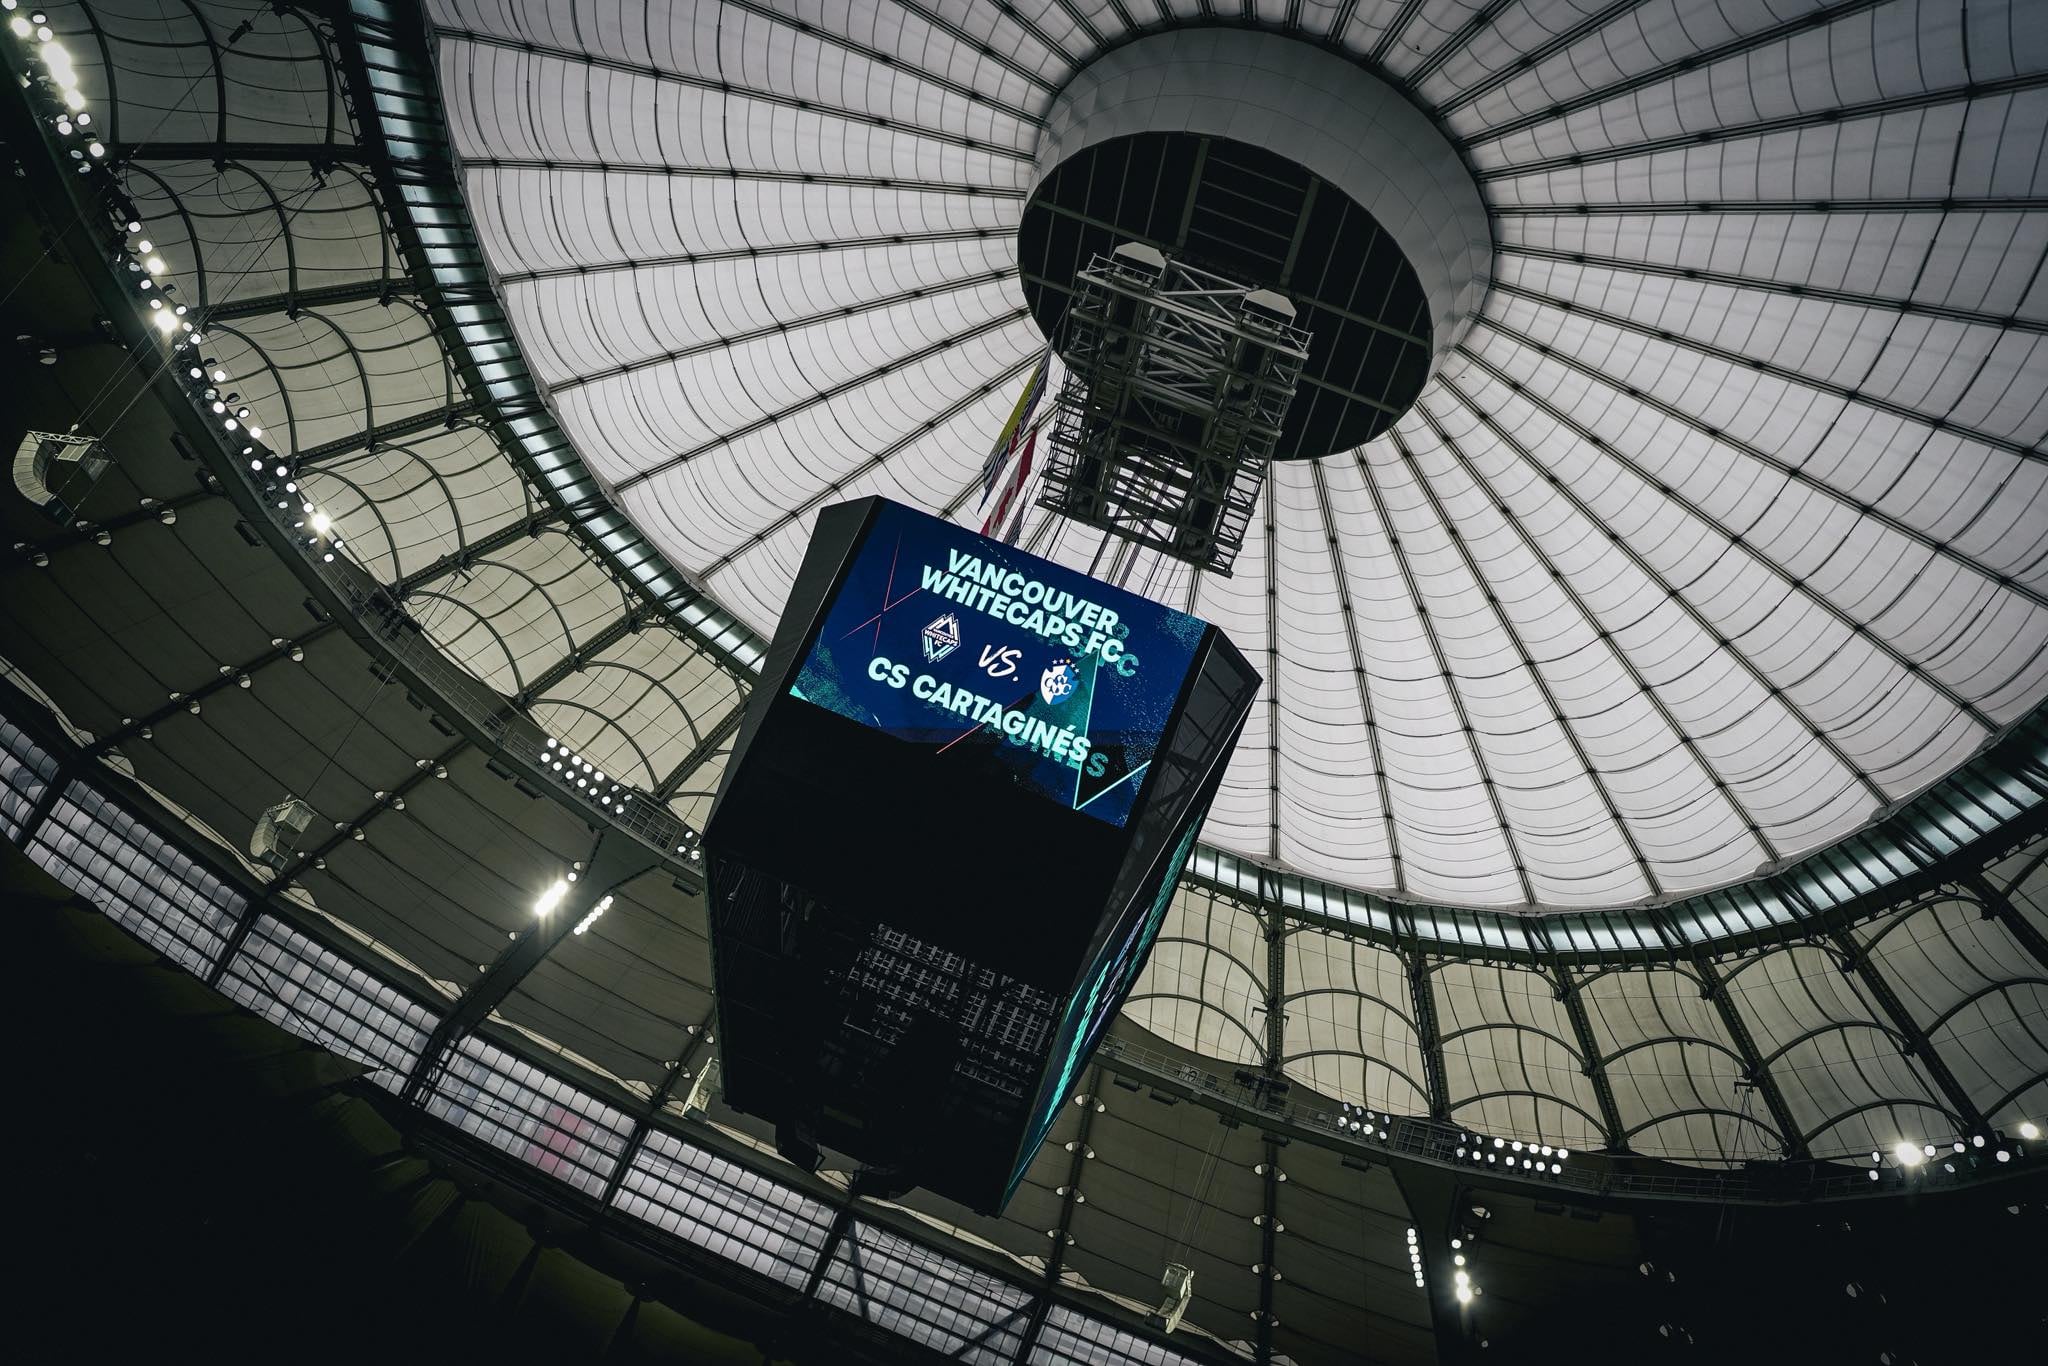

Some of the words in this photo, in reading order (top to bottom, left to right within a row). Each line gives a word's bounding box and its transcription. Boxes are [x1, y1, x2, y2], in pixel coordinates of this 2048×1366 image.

[921, 565, 1083, 647] WHITECAPS
[1084, 631, 1124, 662] FC
[949, 548, 1119, 635] VANCOUVER
[868, 657, 910, 688] CS
[912, 674, 1091, 762] CARTAGINÉS
[978, 645, 1022, 682] VS.
